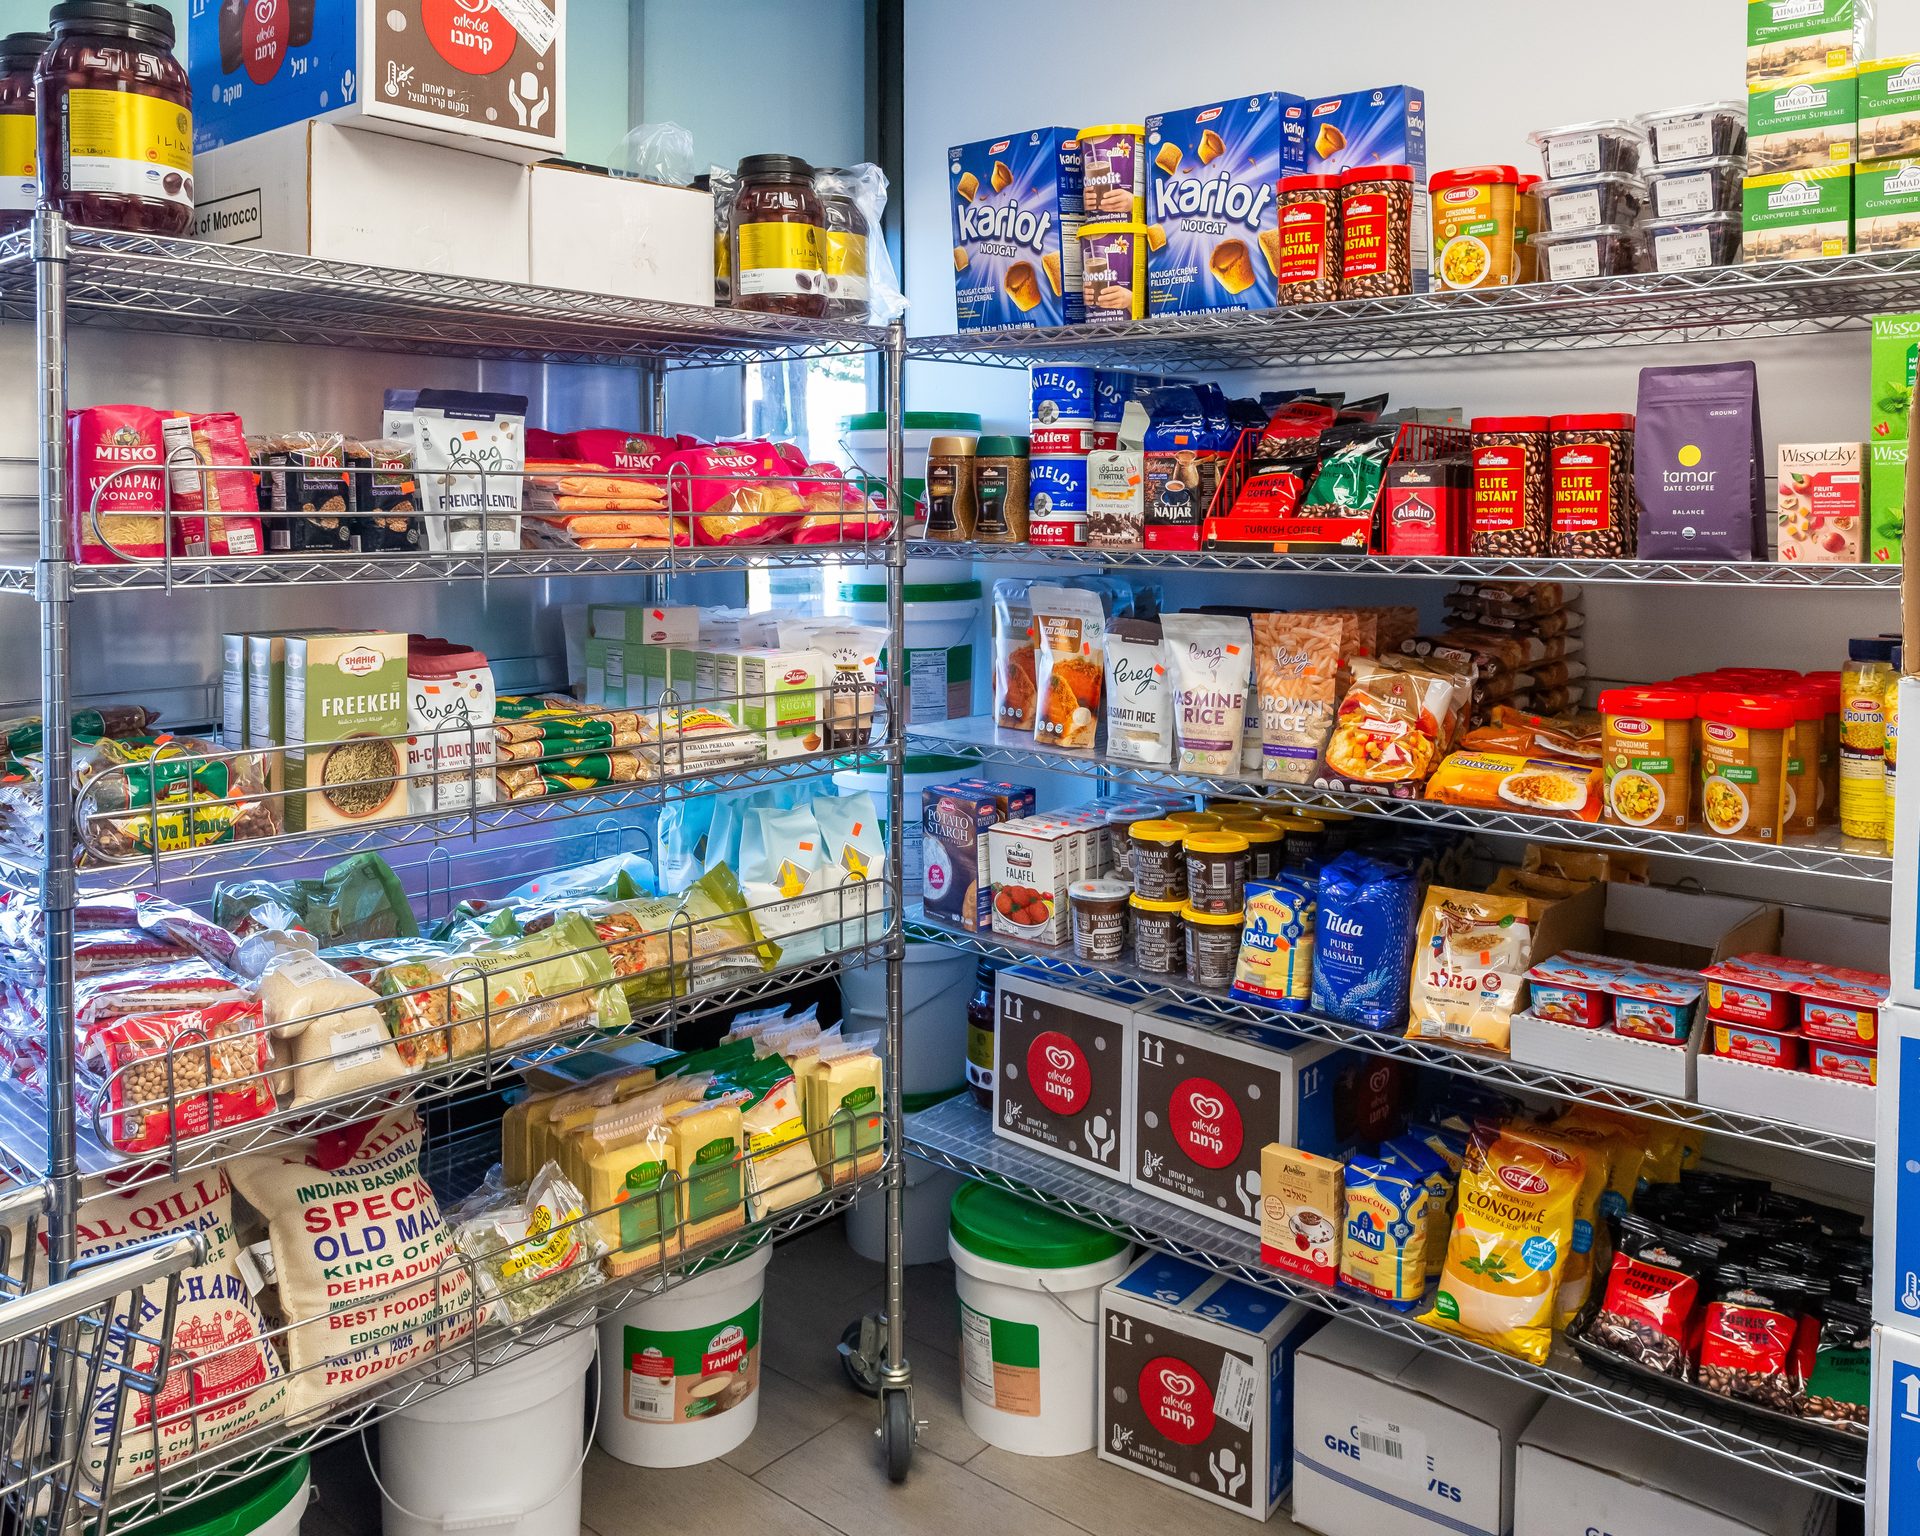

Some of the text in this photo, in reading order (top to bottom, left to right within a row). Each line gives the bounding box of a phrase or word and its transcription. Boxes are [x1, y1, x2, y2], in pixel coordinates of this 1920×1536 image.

[1774, 5, 1806, 18] AHMAD
[453, 13, 489, 34] שטראוס
[255, 41, 277, 61] קרמבו
[451, 29, 493, 55] קרמבו
[1776, 94, 1826, 109] AHMAD TEA
[1156, 171, 1270, 227] kariot
[1770, 190, 1819, 204] AHMAD TEA
[200, 207, 258, 234] of Morocco
[957, 200, 1051, 251] kariot
[1181, 219, 1227, 235] NOUGAT
[1284, 232, 1312, 244] ELITE
[1347, 224, 1373, 238] ELITE
[980, 243, 1017, 258] NOUGAT
[1151, 271, 1175, 280] NOUGAT
[1151, 274, 1195, 286] FILLED CEREAL
[957, 287, 979, 297] NOUGAT
[1033, 431, 1070, 444] Coffee
[96, 446, 157, 462] MISKO
[615, 454, 661, 469] MISKO
[706, 455, 757, 468] MISKO
[1782, 449, 1856, 467] Wissotzky
[1479, 477, 1509, 489] ELITE
[1561, 477, 1593, 489] ELITE
[1662, 469, 1717, 483] tamar
[439, 494, 484, 509] FRENCH
[1475, 490, 1517, 502] INSTANT
[1555, 490, 1603, 502] INSTANT
[1154, 507, 1192, 520] NAJJAR
[1397, 507, 1431, 519] Aladin
[1244, 525, 1323, 535] TURKISH COFFEE
[345, 655, 376, 666] SHAHIA
[1189, 642, 1229, 669] Pereg
[1112, 657, 1161, 696] Pereg
[321, 691, 401, 718] FREEKEH
[1260, 696, 1324, 717] BROWN
[1136, 711, 1157, 724] RICE
[1184, 706, 1225, 726] RICE
[1266, 715, 1307, 732] RICE
[928, 809, 969, 832] POTATO
[928, 821, 969, 842] STARCH
[1007, 848, 1032, 860] Sahadi
[1006, 867, 1036, 883] FALAFEL
[1323, 908, 1363, 937] Tilda
[1246, 931, 1275, 950] DARI
[1330, 937, 1354, 952] PURE
[1323, 948, 1363, 966] BASMATI
[1048, 1070, 1072, 1086] שטראוס
[1045, 1080, 1075, 1103] קרמבו
[1192, 1118, 1221, 1137] שטראוס
[1190, 1131, 1223, 1155] קרמבו
[296, 1179, 360, 1205] INDIAN
[313, 1225, 387, 1262] OLD
[1350, 1224, 1381, 1247] DARI
[323, 1240, 430, 1280] KING OF
[1627, 1267, 1679, 1288] TURKISH
[330, 1280, 457, 1330] BEST FOODS NJ
[350, 1324, 400, 1345] EDISON
[402, 1316, 418, 1330] NJ
[713, 1330, 741, 1349] al wadi
[325, 1345, 421, 1385] PRODUCT
[707, 1347, 744, 1371] TAHINA
[204, 1400, 248, 1423] 4268
[1159, 1405, 1195, 1430] קרמבו
[129, 1447, 163, 1464] SIDE
[258, 1385, 288, 1412] GATE
[222, 1418, 260, 1442] INDIA
[1387, 1423, 1401, 1434] 528
